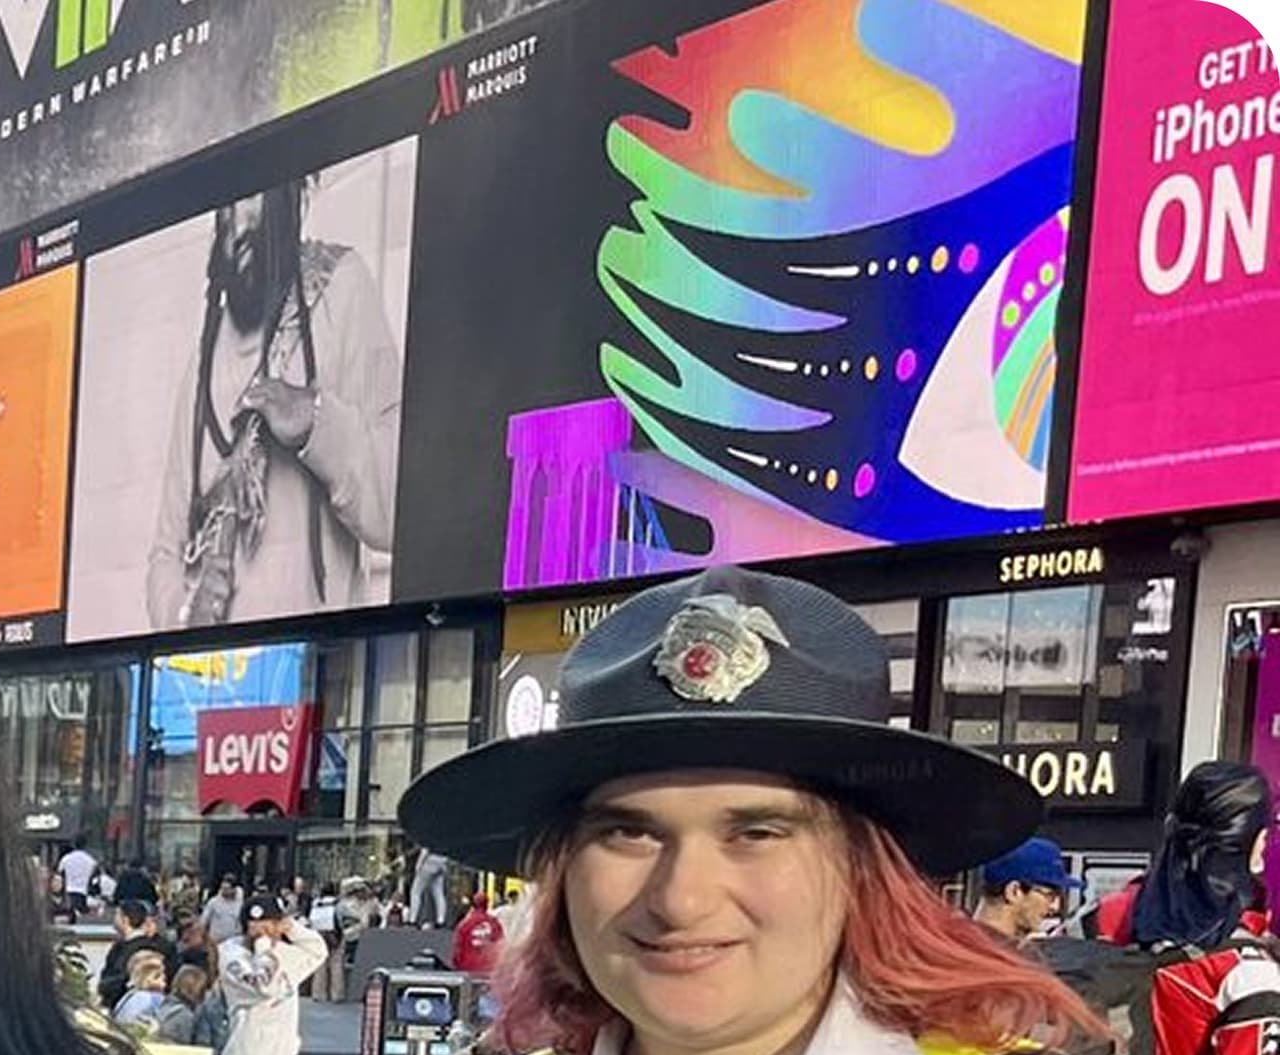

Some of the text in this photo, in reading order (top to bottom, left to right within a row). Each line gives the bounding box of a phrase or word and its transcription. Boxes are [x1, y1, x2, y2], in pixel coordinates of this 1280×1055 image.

[467, 35, 537, 79] MARRIOTT
[1199, 40, 1254, 89] GET
[1139, 154, 1274, 295] ON
[1000, 547, 1104, 582] SEPHORA
